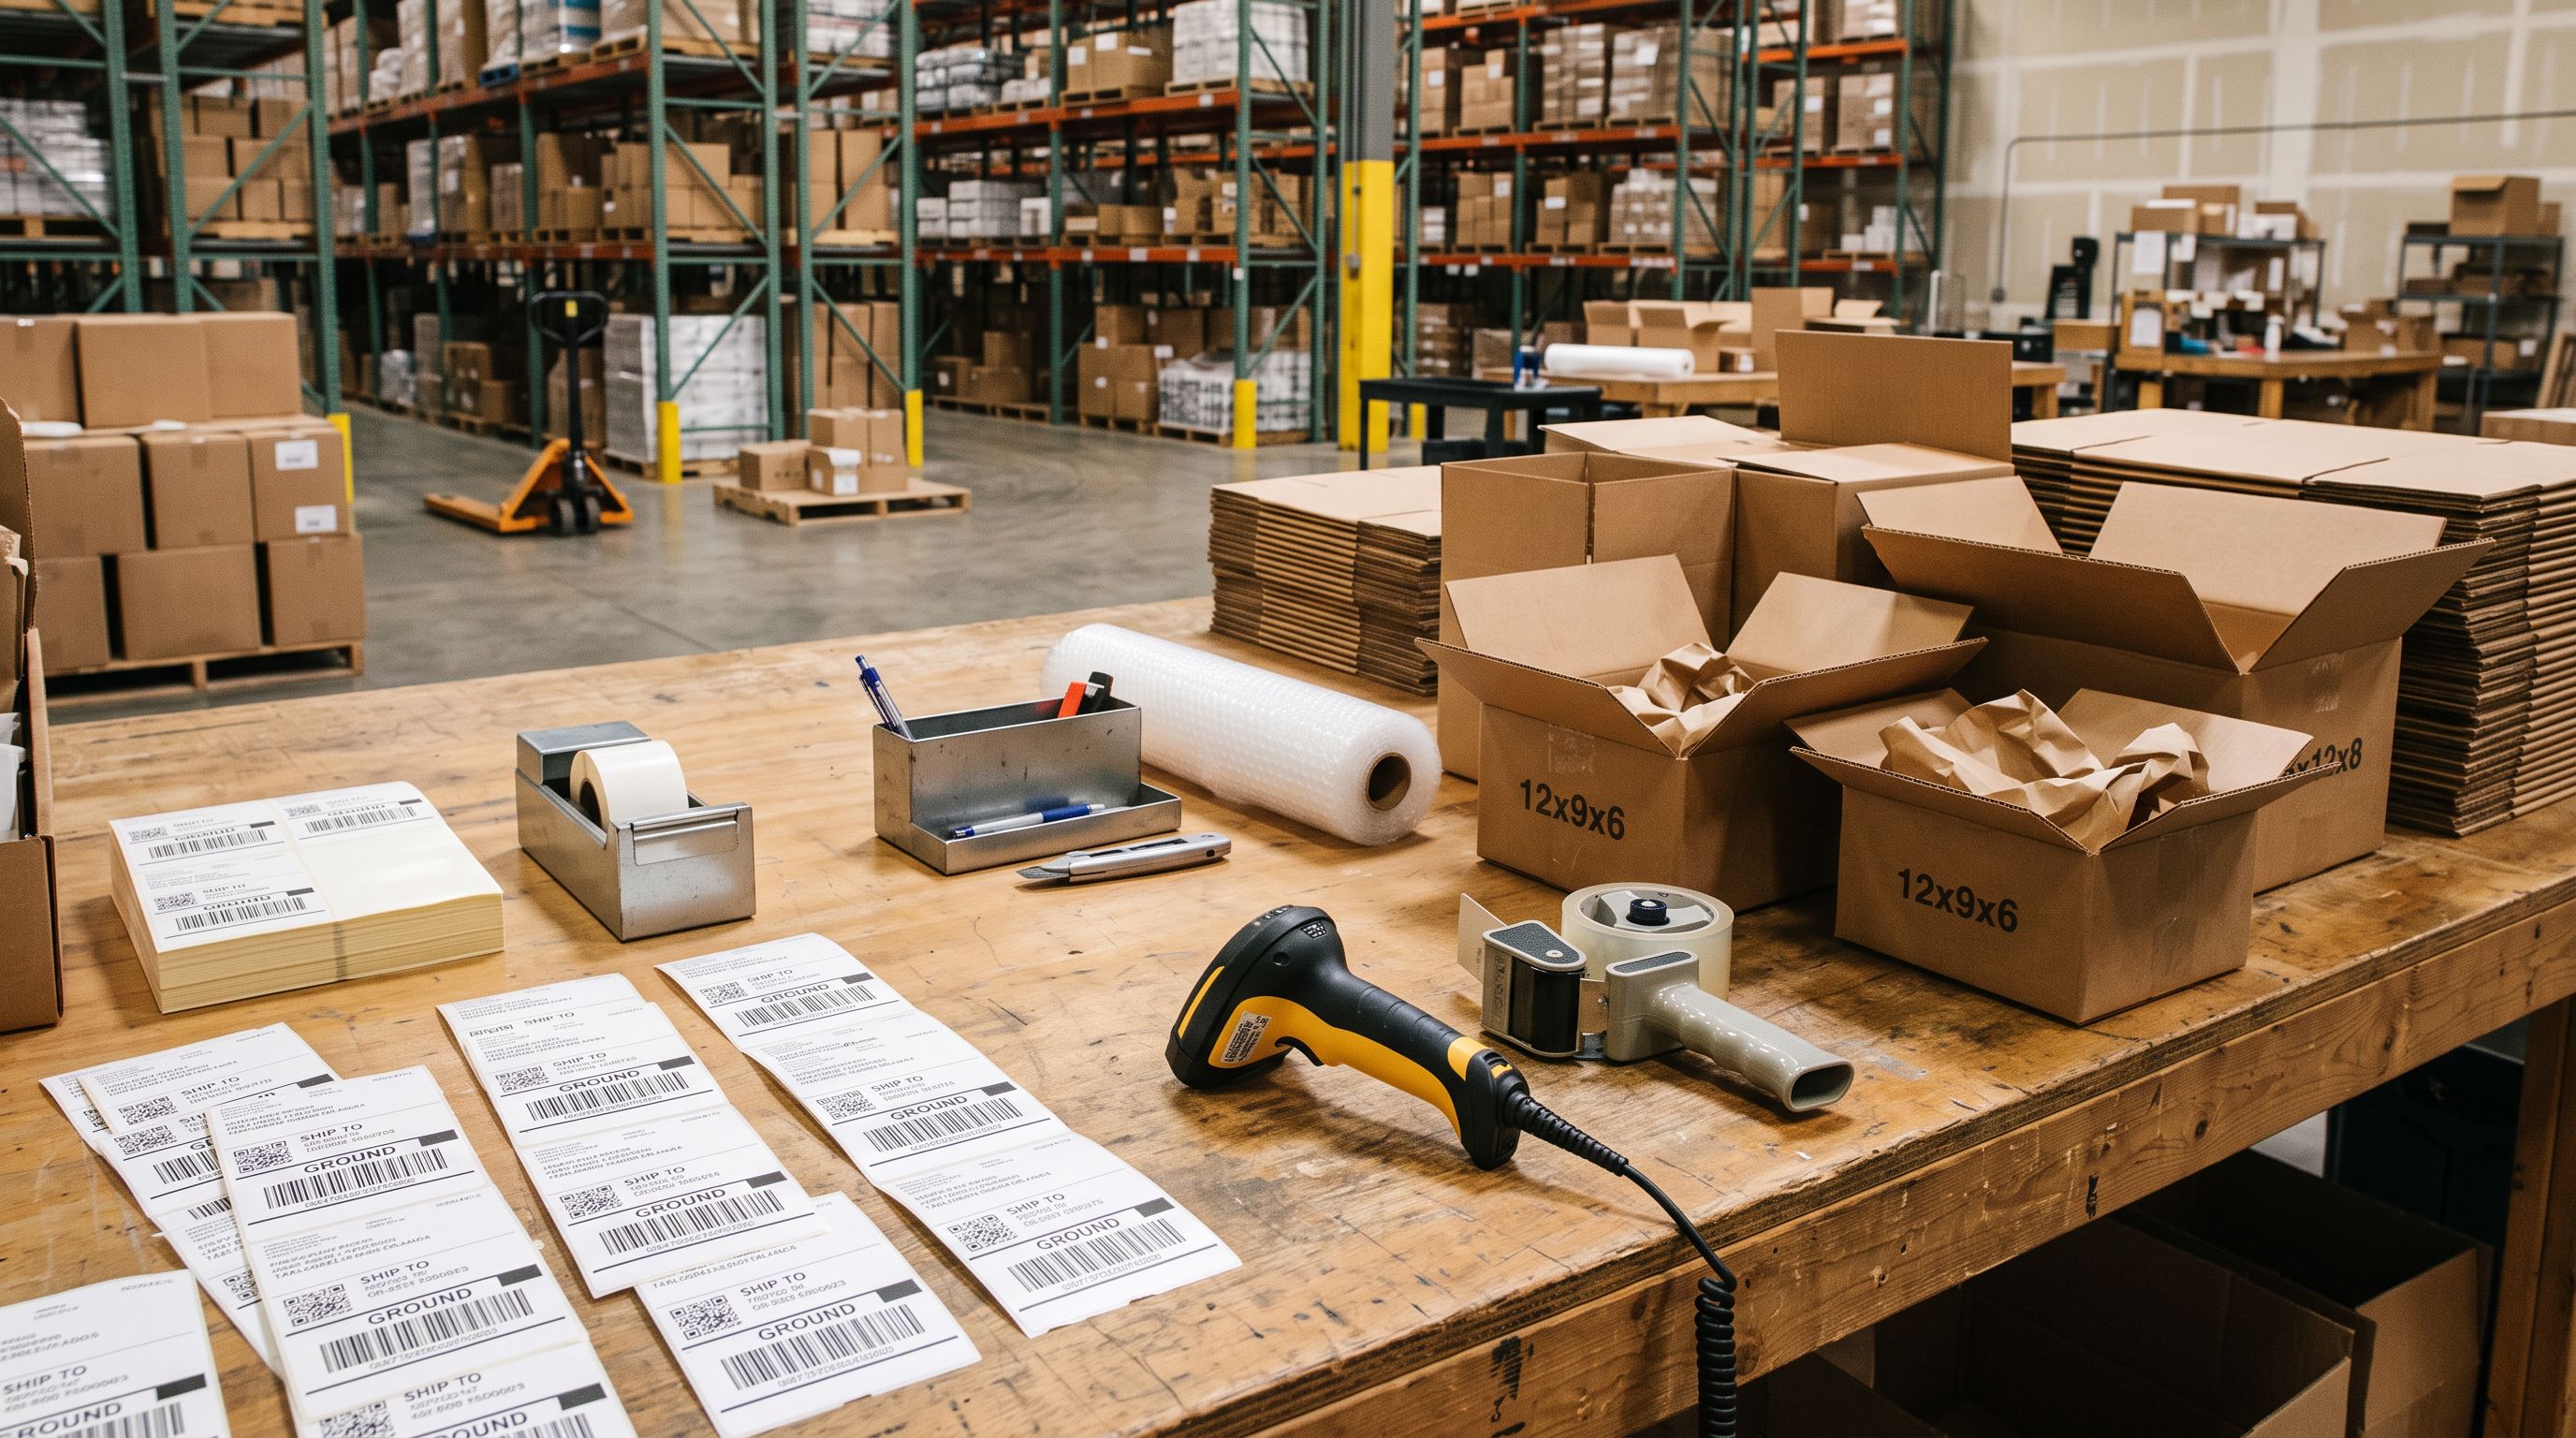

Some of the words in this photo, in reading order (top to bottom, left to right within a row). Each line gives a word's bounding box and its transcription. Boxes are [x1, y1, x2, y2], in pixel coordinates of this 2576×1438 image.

[1520, 779, 1625, 840] 12x9x6
[1898, 868, 2019, 932] 12x9x6
[871, 1079, 901, 1092] SHIP
[890, 1095, 968, 1121] GROUND
[300, 1128, 337, 1142] SHIP
[342, 1123, 363, 1133] TO
[303, 1146, 396, 1173] GROUND
[624, 1171, 660, 1186] SHIP
[665, 1167, 685, 1176] TO
[635, 1189, 726, 1218] GROUND
[1006, 1200, 1040, 1215] SHIP
[1043, 1193, 1065, 1204] TO
[1036, 1218, 1120, 1250] GROUND
[360, 1268, 401, 1284] SHIP
[404, 1260, 430, 1272] TO
[740, 1280, 778, 1297] SHIP
[782, 1272, 806, 1284] TO
[368, 1288, 472, 1325] GROUND
[758, 1303, 856, 1341] GROUND
[3, 1374, 52, 1395] SHIP
[58, 1365, 88, 1380] TO
[403, 1380, 449, 1402] SHIP
[455, 1372, 482, 1387] TO
[0, 1401, 123, 1438] ROUND
